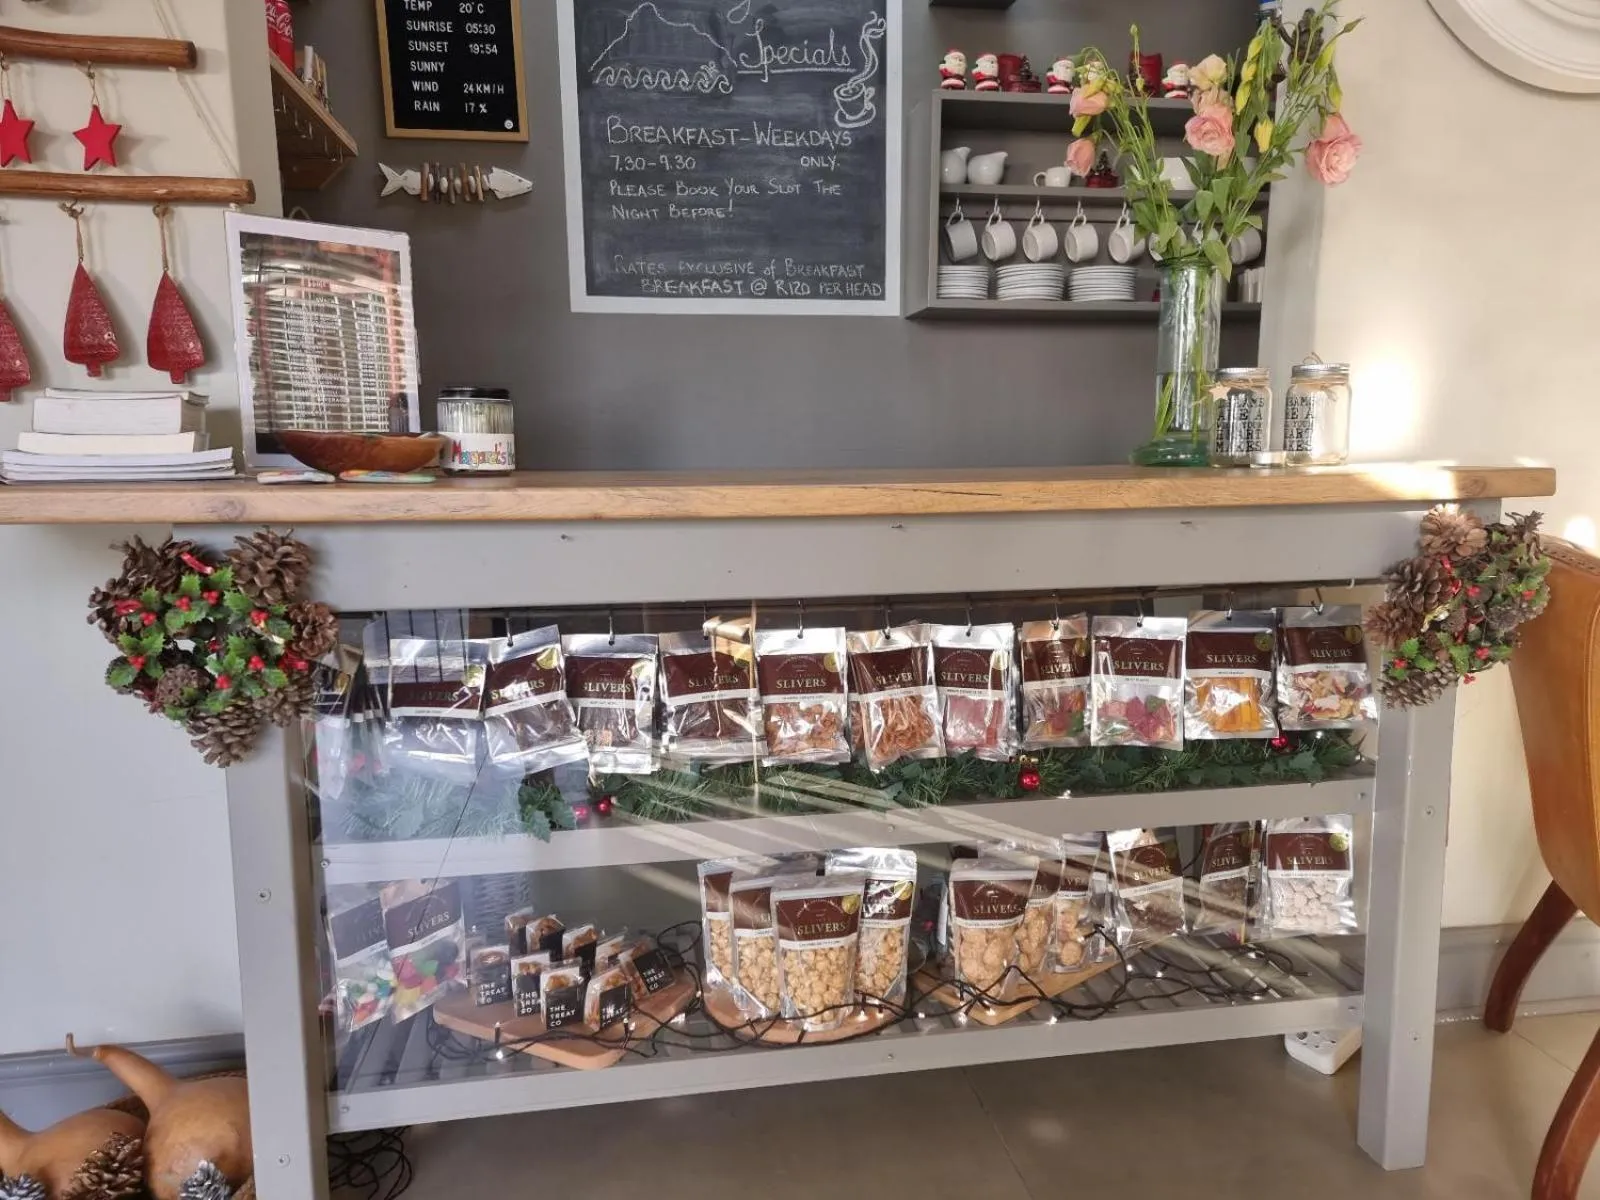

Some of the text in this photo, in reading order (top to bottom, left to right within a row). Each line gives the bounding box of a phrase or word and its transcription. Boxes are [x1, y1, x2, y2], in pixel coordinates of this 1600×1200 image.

[404, 0, 433, 11] TEMP
[406, 20, 496, 35] SUNRISE 05:30
[408, 40, 449, 53] SUNSET
[739, 18, 850, 83] Specials
[410, 60, 445, 73] SUNNY
[412, 80, 439, 92] WIND
[414, 100, 440, 112] RAIN
[750, 279, 768, 296] @
[1206, 653, 1258, 665] SLIVERS
[1114, 660, 1165, 672] SLIVERS
[776, 677, 828, 690] SLIVERS
[941, 670, 990, 684] SLIVERS
[797, 922, 847, 937] SLIVERS
[549, 1004, 567, 1013] THE
[549, 1009, 577, 1020] TREAT
